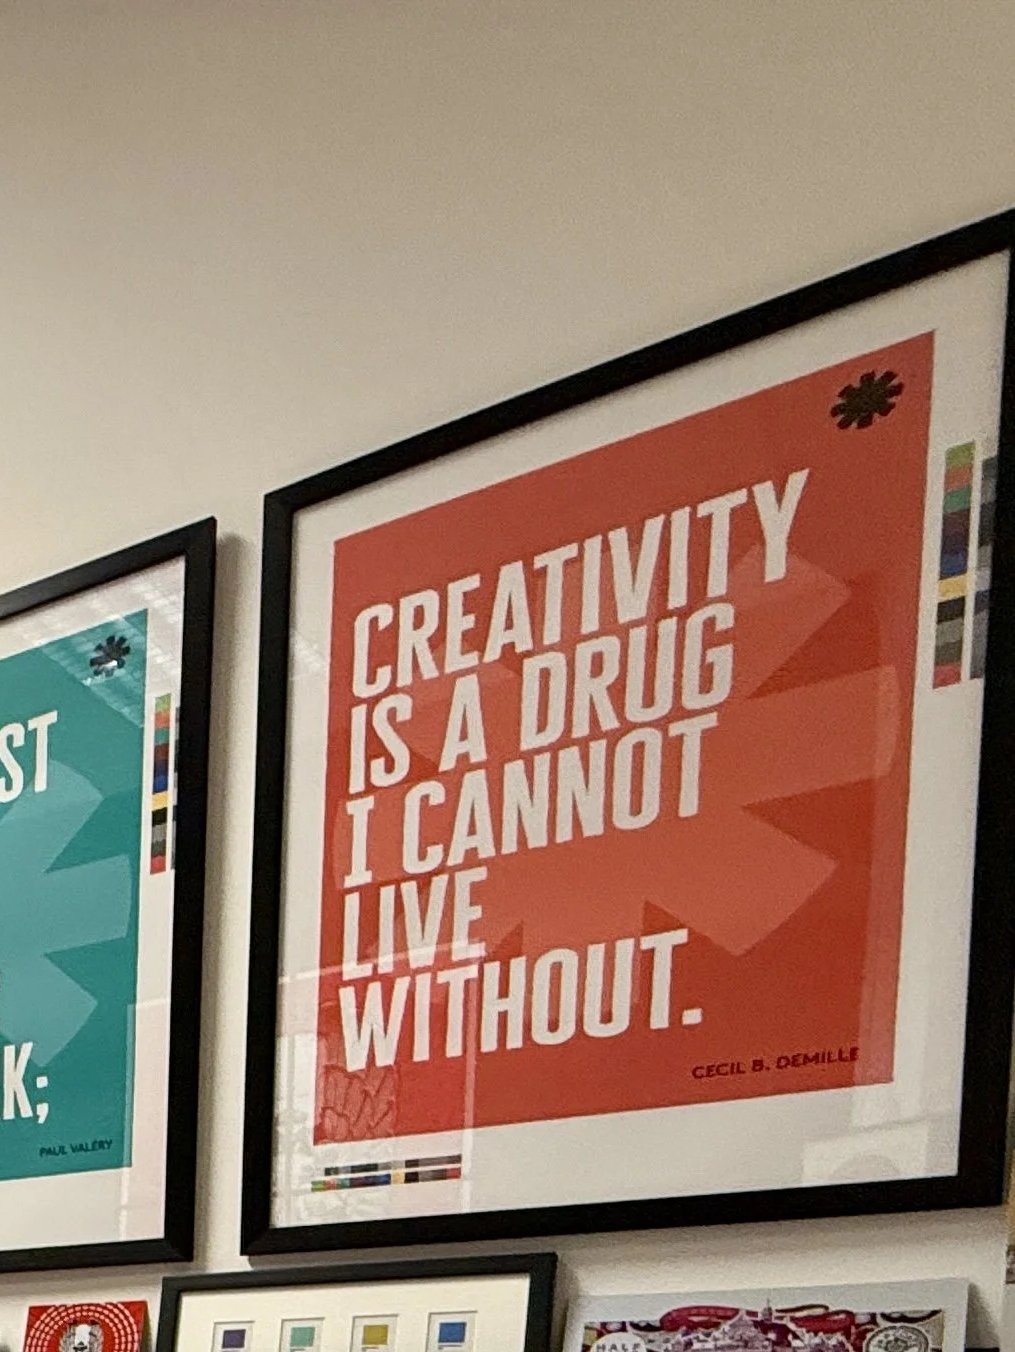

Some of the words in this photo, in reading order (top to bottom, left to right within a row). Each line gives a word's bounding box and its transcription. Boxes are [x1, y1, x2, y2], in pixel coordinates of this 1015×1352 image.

[352, 469, 808, 699] CREATIVITY
[349, 693, 413, 794] IS
[439, 673, 487, 772] A
[520, 603, 735, 751] DRUG
[343, 795, 375, 888] I
[402, 713, 717, 874] CANNOT
[342, 866, 487, 981] LIVE
[339, 929, 702, 1072] WITHOUT.
[691, 1062, 746, 1080] CECIL
[752, 1059, 770, 1072] B.
[776, 1047, 859, 1070] DEMILLE
[39, 1145, 67, 1158] PAUL
